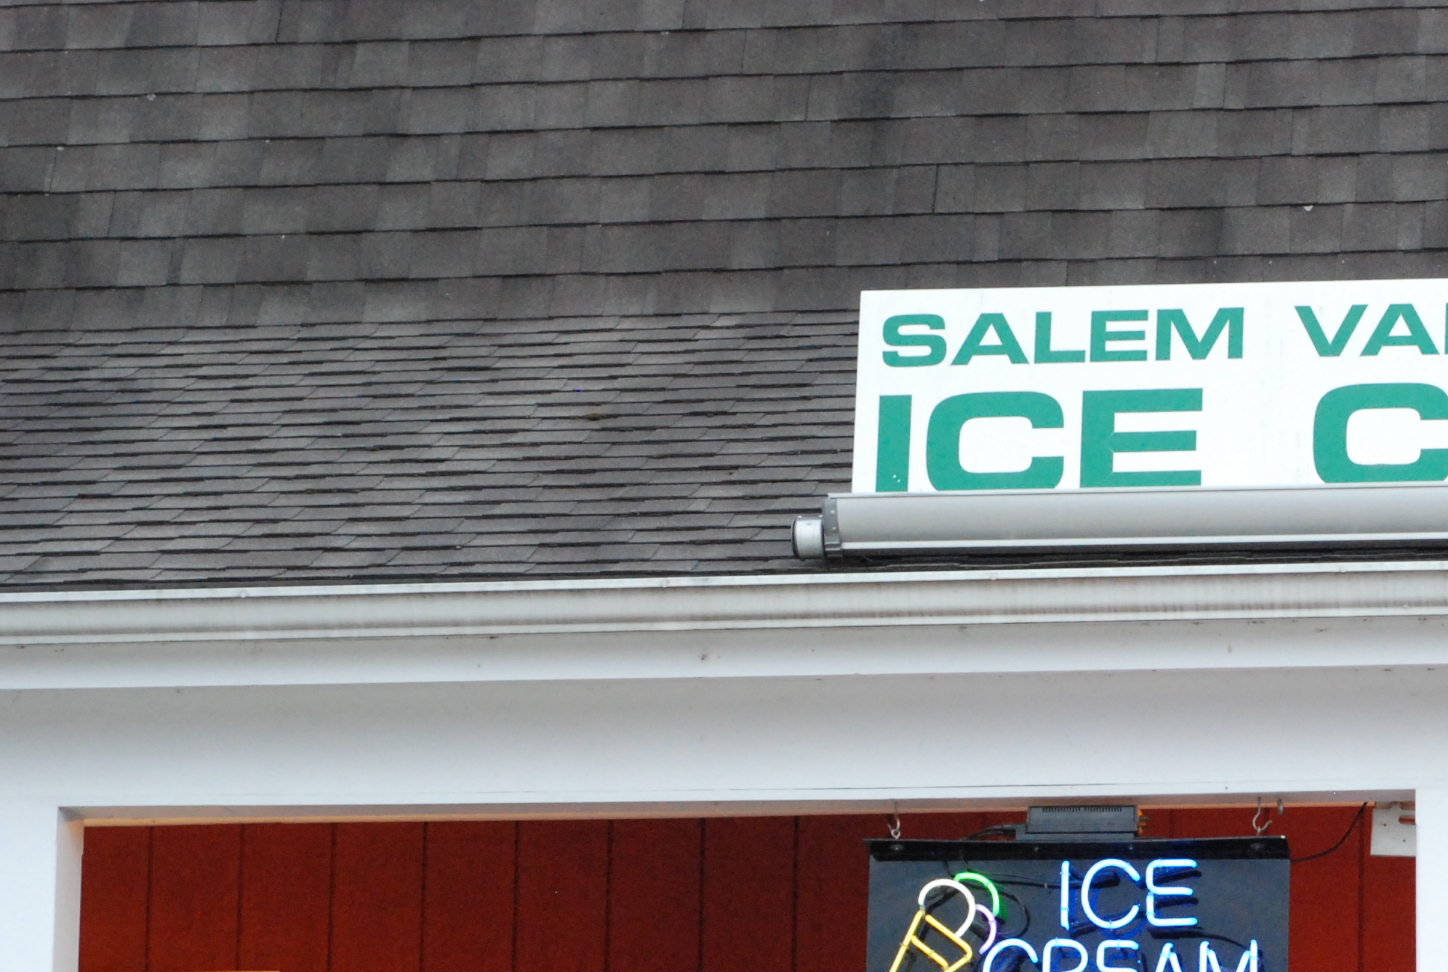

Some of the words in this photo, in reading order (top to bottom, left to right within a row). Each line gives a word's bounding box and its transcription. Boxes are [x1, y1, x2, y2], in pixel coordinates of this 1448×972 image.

[882, 304, 1245, 368] SALEM
[876, 386, 1205, 493] ICE
[1060, 858, 1198, 931] ICE
